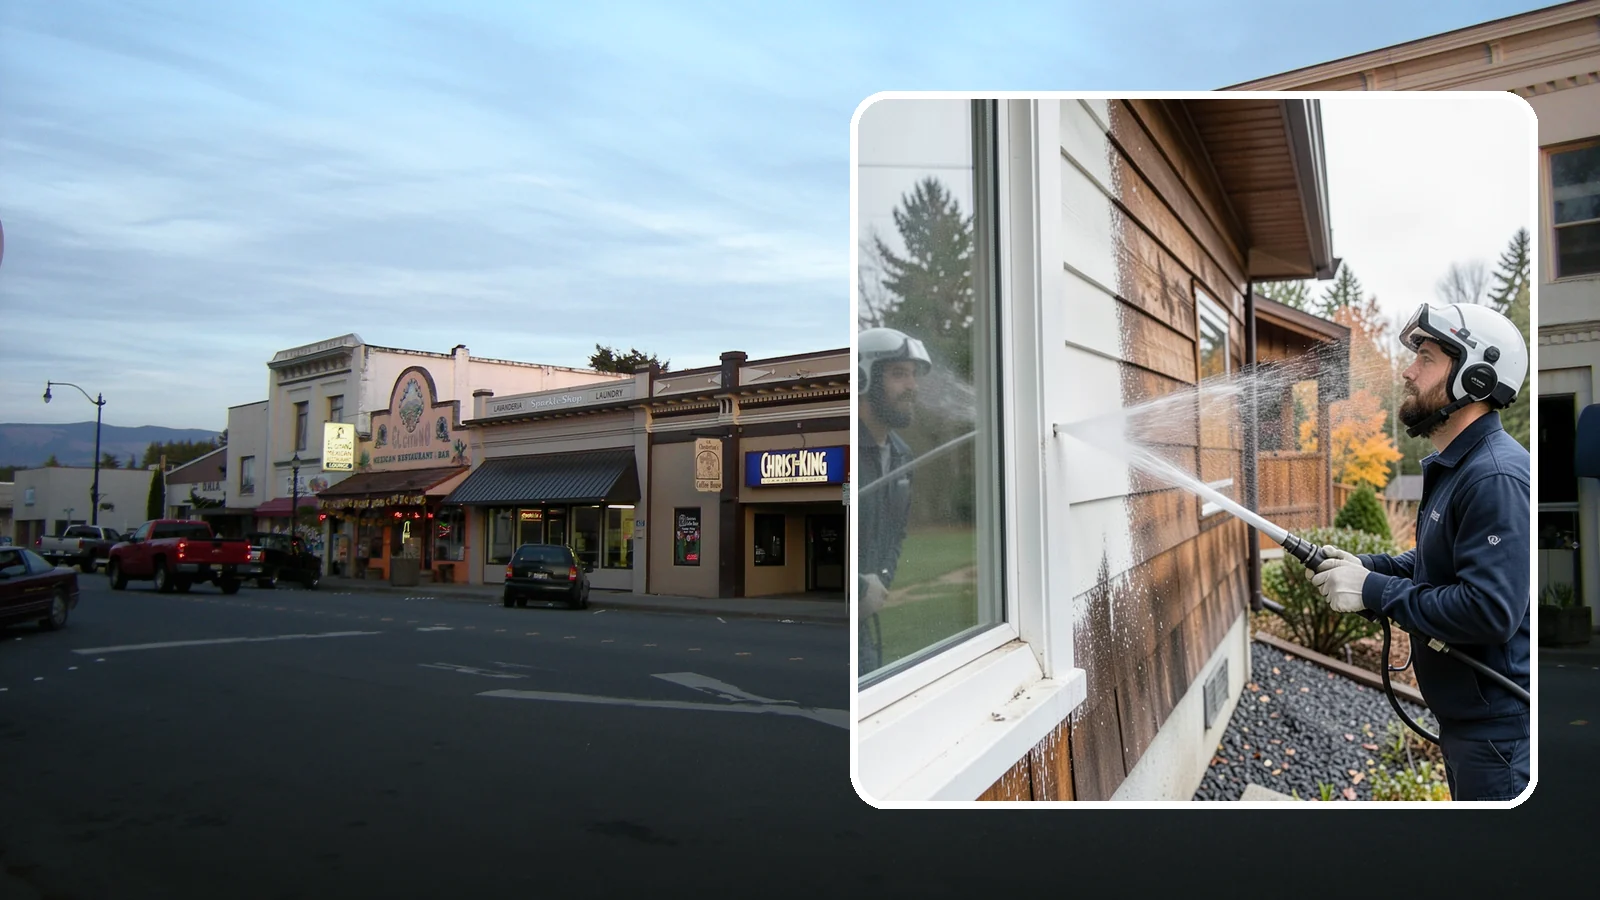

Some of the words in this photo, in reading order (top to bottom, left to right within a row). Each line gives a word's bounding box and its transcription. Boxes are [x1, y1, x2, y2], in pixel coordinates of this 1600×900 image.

[562, 394, 582, 404] Shop
[595, 389, 623, 400] LAUNDRY
[493, 402, 522, 412] LAVANDERIA
[373, 455, 396, 464] MEXICAN
[397, 451, 433, 462] RESTAURANT
[438, 450, 449, 459] BAR
[761, 452, 797, 478] CHRIST
[799, 450, 827, 476] KING
